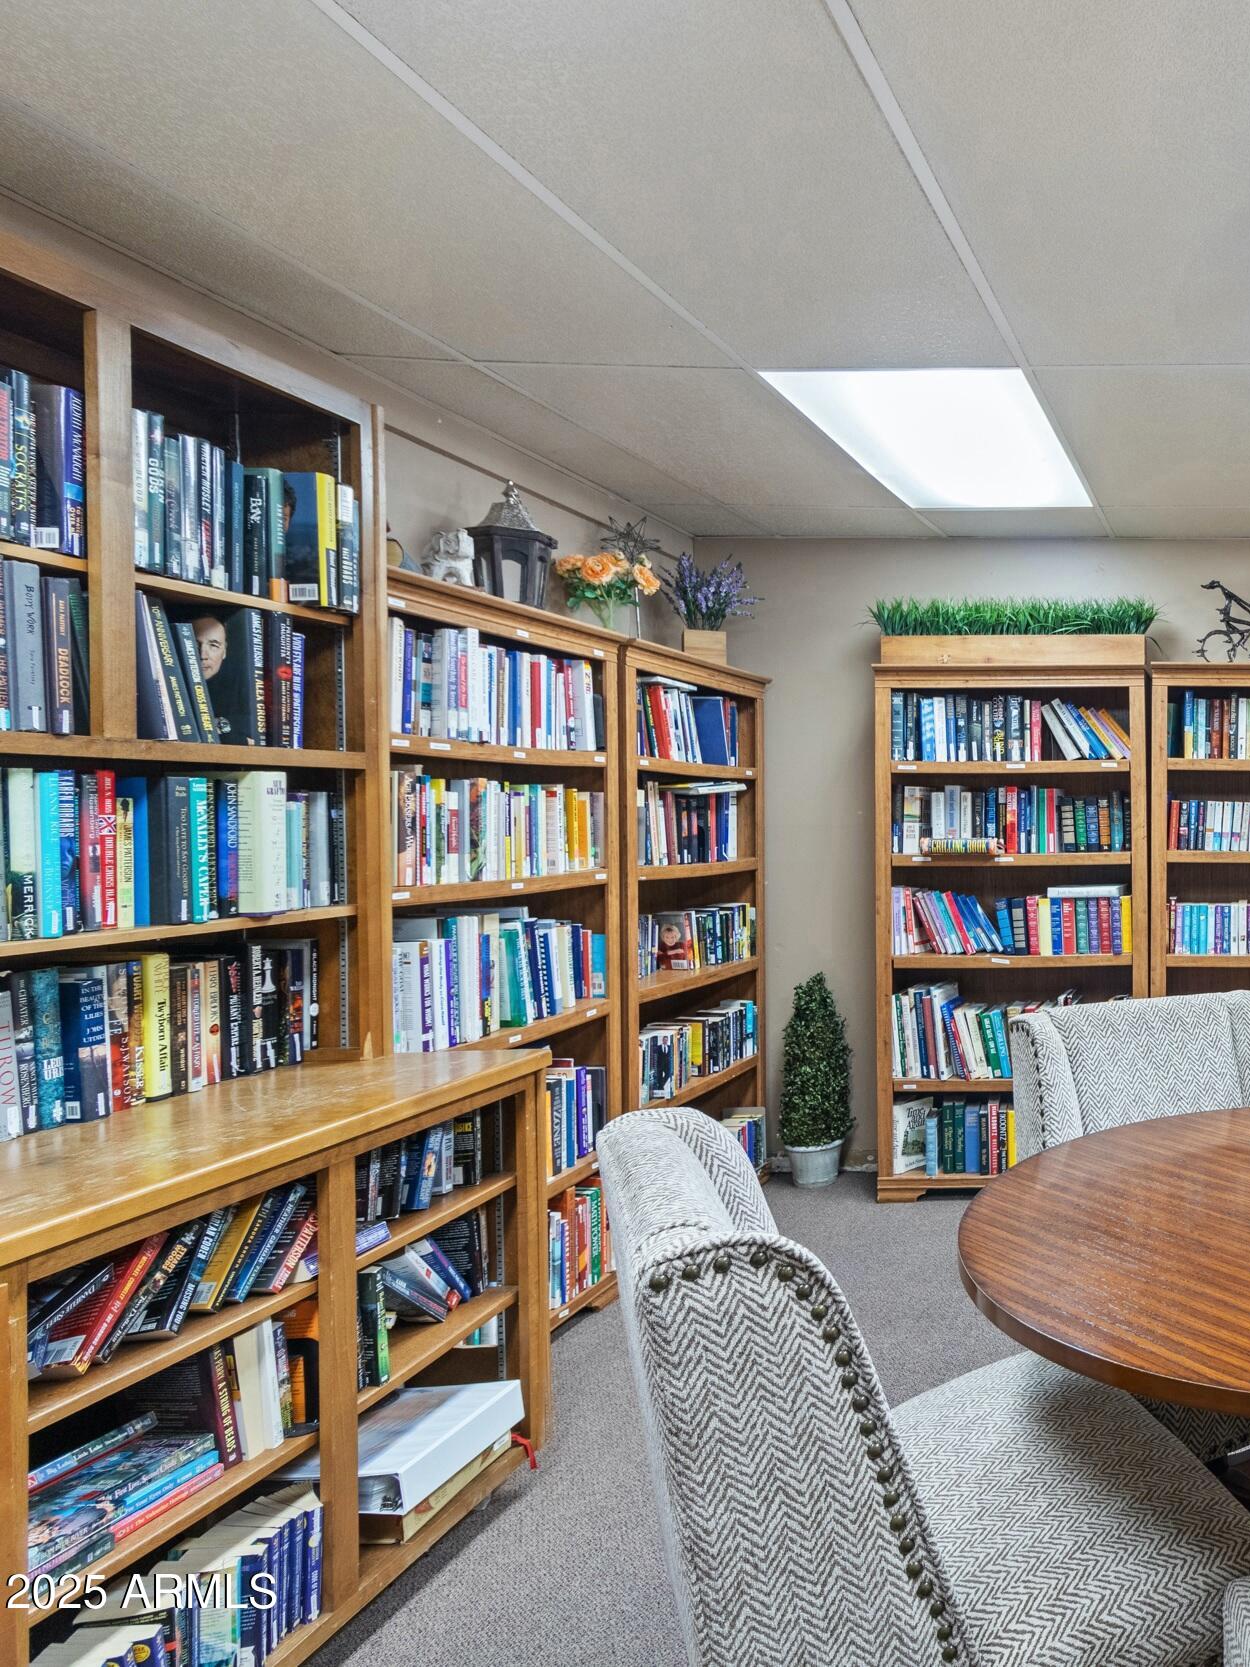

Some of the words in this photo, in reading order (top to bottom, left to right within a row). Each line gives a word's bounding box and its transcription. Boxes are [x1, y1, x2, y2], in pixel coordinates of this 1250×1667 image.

[72, 396, 83, 431] JUDITH
[72, 432, 82, 481] McNAUGHT
[201, 444, 210, 477] WALTER
[15, 443, 29, 512] SOCRATES
[148, 458, 159, 494] GODS
[202, 480, 210, 513] MOSLEY
[342, 560, 352, 584] ROADS
[26, 612, 36, 634] WORK
[252, 612, 262, 636] JAMES
[154, 620, 174, 666] ANNIVERSARY
[184, 638, 193, 656] JAMES
[254, 637, 264, 668] PATTERSON
[58, 648, 72, 704] DEADLOCK
[188, 656, 201, 682] PATTERSON
[169, 676, 179, 690] JAMES
[195, 685, 207, 703] CROSS
[256, 679, 265, 700] ALEX
[172, 691, 186, 716] PATTERSON
[198, 704, 208, 714] MY
[200, 714, 212, 731] HEART
[257, 703, 266, 732] CROSS
[60, 776, 74, 800] KAREN
[225, 782, 238, 805] JOHN
[88, 794, 96, 838] Rosenberg
[208, 804, 216, 848] SANDFORD
[228, 805, 237, 848] SANDFORD
[124, 824, 132, 846] JAMES
[182, 840, 188, 848] TO
[932, 840, 966, 852] GRILLING
[967, 840, 988, 852] BOOK
[106, 836, 114, 864] DOUBLE
[106, 865, 114, 888] CROSS
[124, 848, 132, 883] PATTERSON
[23, 874, 34, 937] MERRICK
[133, 965, 144, 1000] STUART
[208, 964, 218, 988] TERRY
[19, 988, 29, 1026] CHEATER
[84, 1012, 104, 1020] LILIES
[156, 998, 168, 1042] Twyborn
[210, 992, 218, 1022] BROOKS
[86, 1025, 104, 1034] JOHN
[230, 1022, 239, 1046] EMPIRE
[0, 1022, 17, 1107] TUROW
[135, 1046, 145, 1088] KISSER
[20, 1063, 31, 1107] ROSENBERG
[248, 1218, 262, 1244] SANDRA
[274, 1204, 294, 1234] HEATHER
[162, 1244, 182, 1270] WOODS
[198, 1234, 214, 1260] COBEN
[236, 1245, 248, 1268] BROWN
[258, 1236, 276, 1263] GRAHAM
[286, 1222, 316, 1268] PATTERSON
[132, 1256, 148, 1278] MICHAEL
[168, 1246, 187, 1274] STUART
[65, 1284, 96, 1310] DANIELLE
[120, 1276, 136, 1300] CONNELLY
[182, 1283, 196, 1310] MISSING
[134, 1295, 148, 1310] Two
[106, 1312, 114, 1324] THE
[121, 1308, 136, 1330] Dollar
[174, 1309, 184, 1326] YOU
[94, 1320, 108, 1344] BURNING
[82, 1341, 94, 1362] ROOM
[215, 1360, 226, 1382] PERRY
[218, 1381, 226, 1390] A
[219, 1388, 231, 1416] STRING
[223, 1416, 232, 1428] OF
[224, 1427, 236, 1452] BEADS
